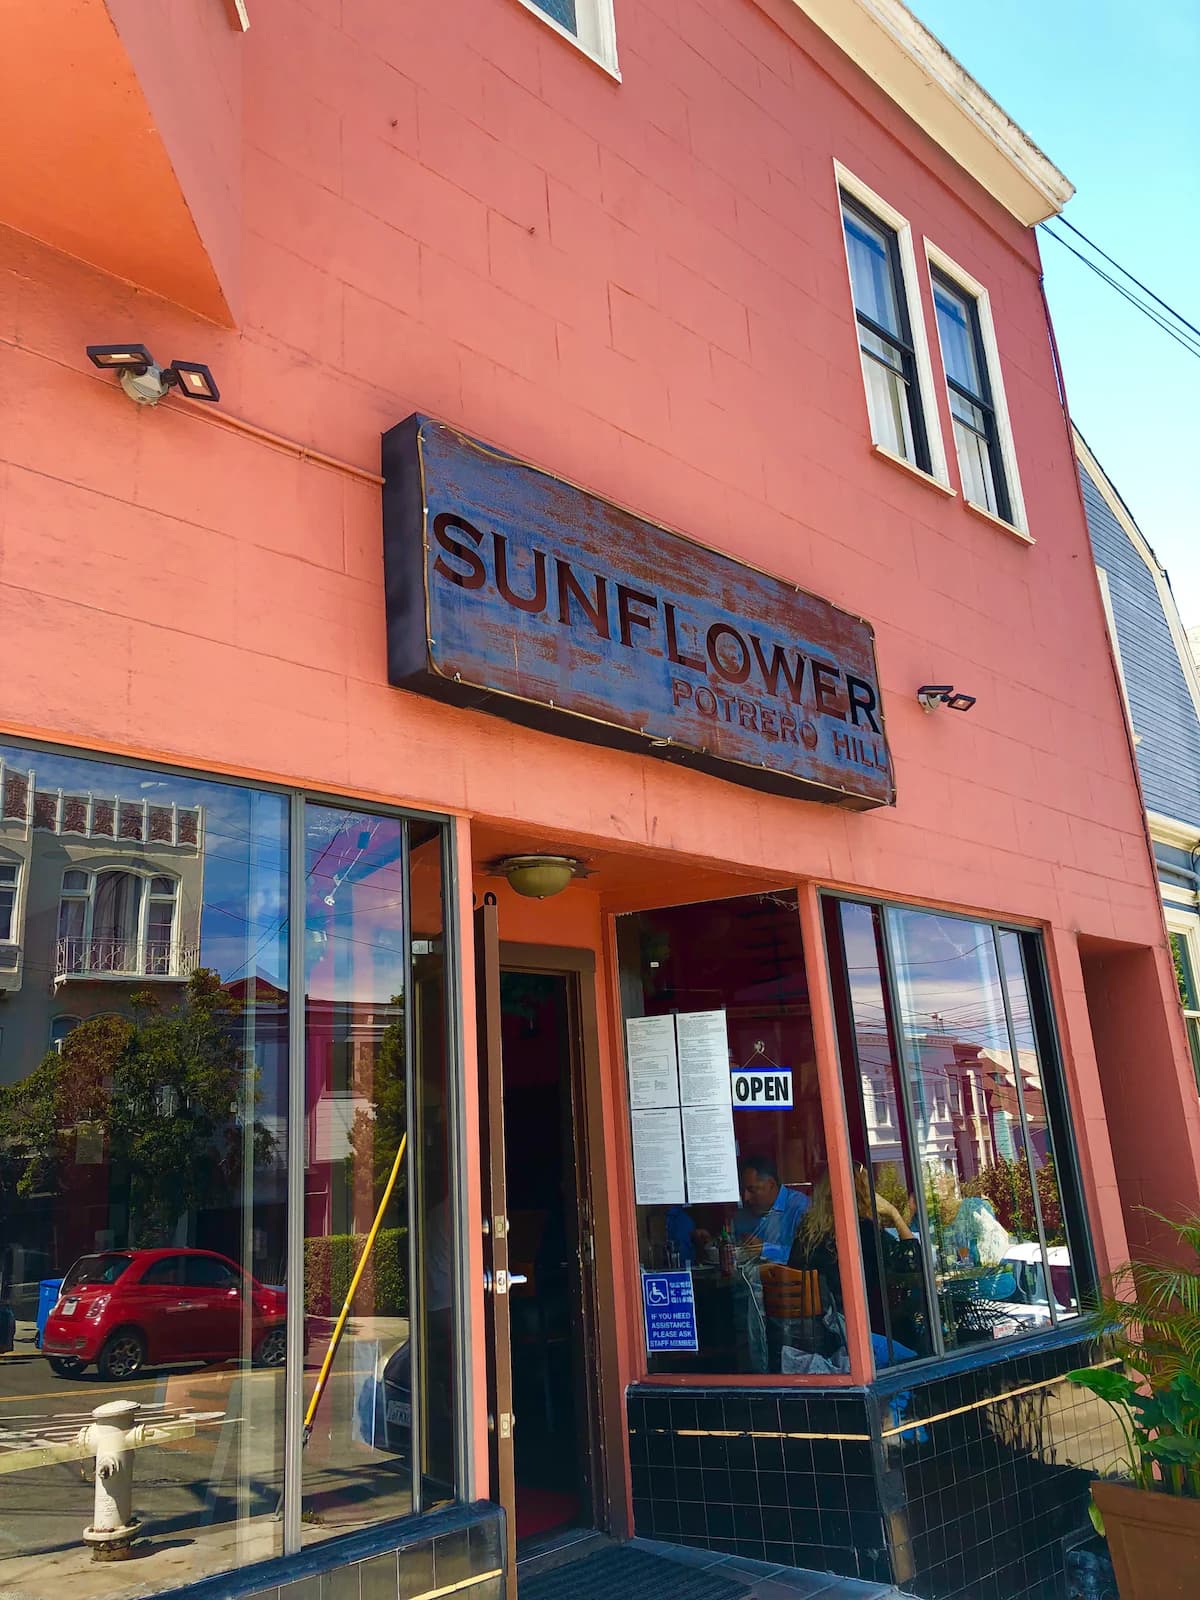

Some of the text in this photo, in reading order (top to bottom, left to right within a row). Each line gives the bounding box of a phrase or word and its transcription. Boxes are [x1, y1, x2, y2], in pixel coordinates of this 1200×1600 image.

[433, 512, 882, 735] SUNFLOWER
[672, 677, 888, 773] POTRERO HILL
[735, 1076, 789, 1102] OPEN
